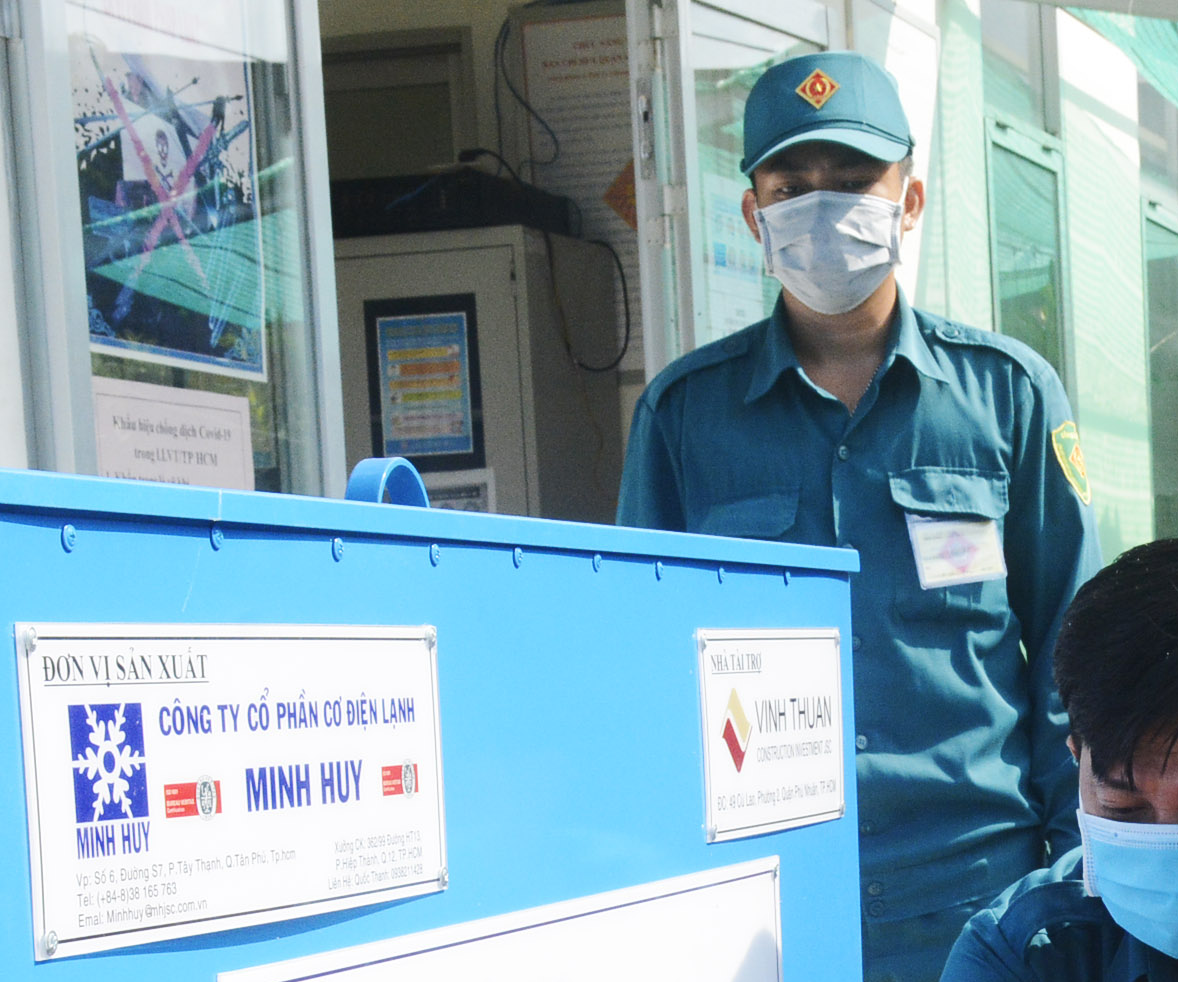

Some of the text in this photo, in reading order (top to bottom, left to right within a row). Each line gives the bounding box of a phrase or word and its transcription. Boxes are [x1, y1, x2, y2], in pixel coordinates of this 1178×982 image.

[199, 426, 231, 441] Covid-19
[134, 448, 155, 463] trong
[196, 452, 218, 467] HCM
[42, 647, 208, 687] ĐƠN VỊ SẢN XUẤT
[710, 649, 729, 672] NHÀ
[730, 648, 745, 671] TÀI
[159, 687, 415, 736] CÔNG TY CỔ PHẦN CƠ ĐIỆN LẠNH
[755, 695, 832, 734] VINH THUAN
[245, 759, 362, 812] MINH HUY
[76, 820, 150, 860] MINH HUY
[76, 872, 92, 890] Vp:
[94, 867, 106, 885] Số
[109, 869, 118, 884] 6,
[151, 863, 166, 878] S7,
[168, 860, 193, 876] P.Tây
[225, 853, 250, 869] Q.Tân
[77, 881, 177, 909] Tel: (+84-8)38 165 763
